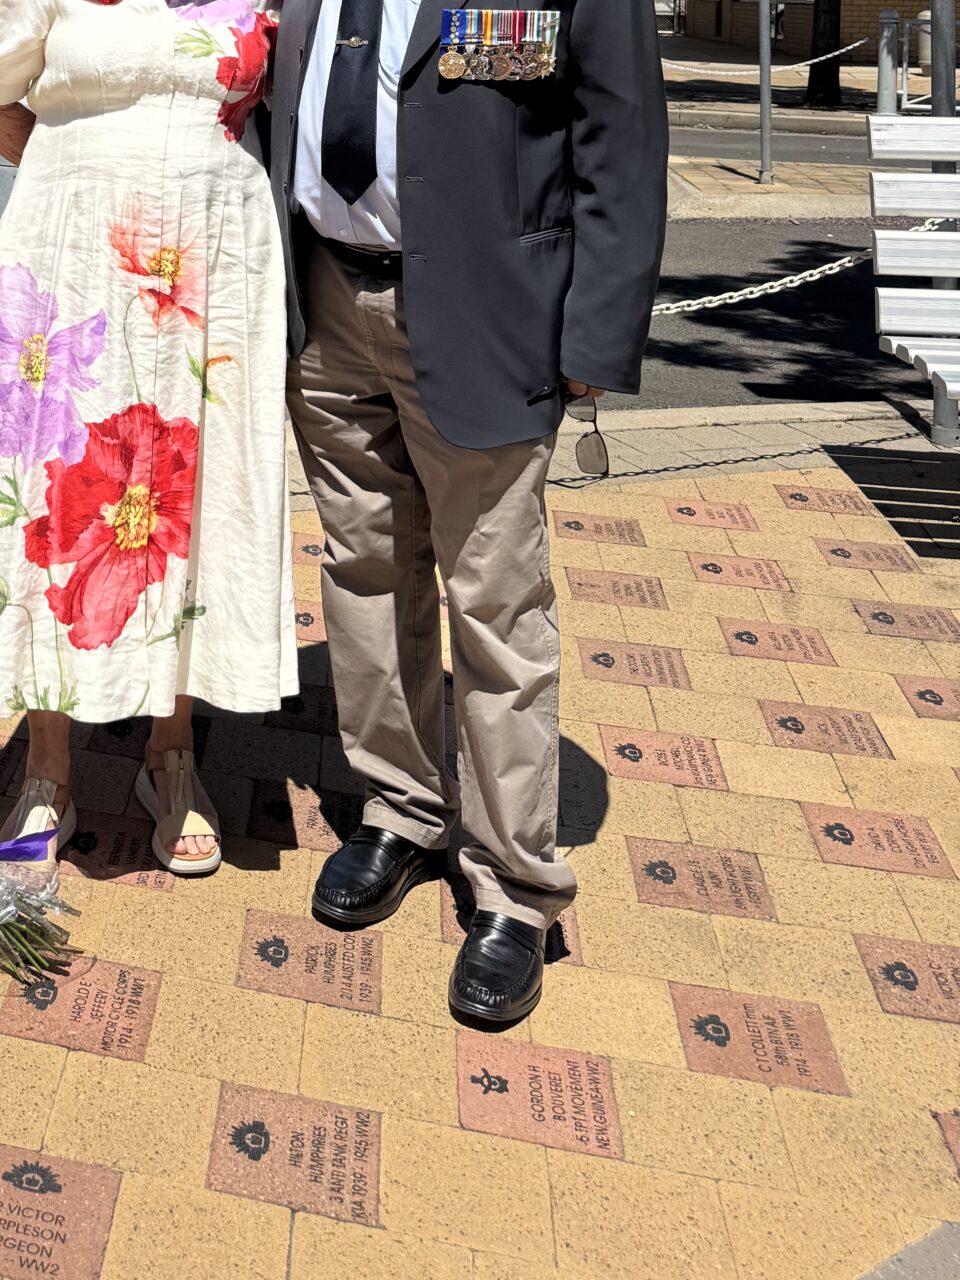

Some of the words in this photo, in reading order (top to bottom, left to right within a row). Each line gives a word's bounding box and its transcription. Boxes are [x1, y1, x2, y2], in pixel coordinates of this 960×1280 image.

[891, 817, 912, 838] HORSE
[901, 837, 921, 856] LIGHT
[719, 855, 737, 878] HORSE
[690, 868, 710, 896] CLAUDE
[726, 877, 744, 898] LIGHT
[743, 881, 762, 905] EGYPT
[342, 932, 355, 951] COY
[360, 936, 373, 957] WW2
[303, 943, 319, 975] PATRICK
[321, 940, 337, 984] HUMPHRIES
[341, 950, 354, 962] FD
[359, 956, 373, 977] 1945
[114, 968, 131, 995] CORPS
[339, 979, 353, 1000] 2/14
[358, 981, 372, 1004] 1939
[68, 987, 90, 1023] HAROLD
[88, 988, 109, 1023] JEFFERY
[108, 994, 125, 1021] CYCLE
[124, 998, 141, 1020] 1918
[778, 1008, 798, 1032] WW1
[100, 1019, 119, 1051] MOTOR
[117, 1024, 135, 1050] 1914
[743, 1018, 768, 1056] COLLETT
[786, 1031, 804, 1050] 1918
[526, 1064, 541, 1073] H
[585, 1059, 601, 1086] WW2
[756, 1063, 772, 1073] C
[793, 1057, 813, 1078] 1914
[527, 1071, 546, 1123] GORDON
[546, 1070, 566, 1122] BOUVERET
[565, 1058, 586, 1117] MOVEMENT
[588, 1084, 608, 1126] GUINEA
[332, 1114, 349, 1141] REGT
[355, 1110, 370, 1139] WW2
[287, 1129, 305, 1168] HILTON
[593, 1125, 610, 1150] NEW
[307, 1123, 327, 1185] HUMPHRIES
[331, 1140, 347, 1170] TANK
[354, 1138, 369, 1163] 1945
[351, 1171, 367, 1197] 1939
[329, 1194, 344, 1204] 3
[350, 1198, 366, 1219] KIA
[8, 1202, 65, 1226] VICTOR
[19, 1255, 61, 1276] WW2
